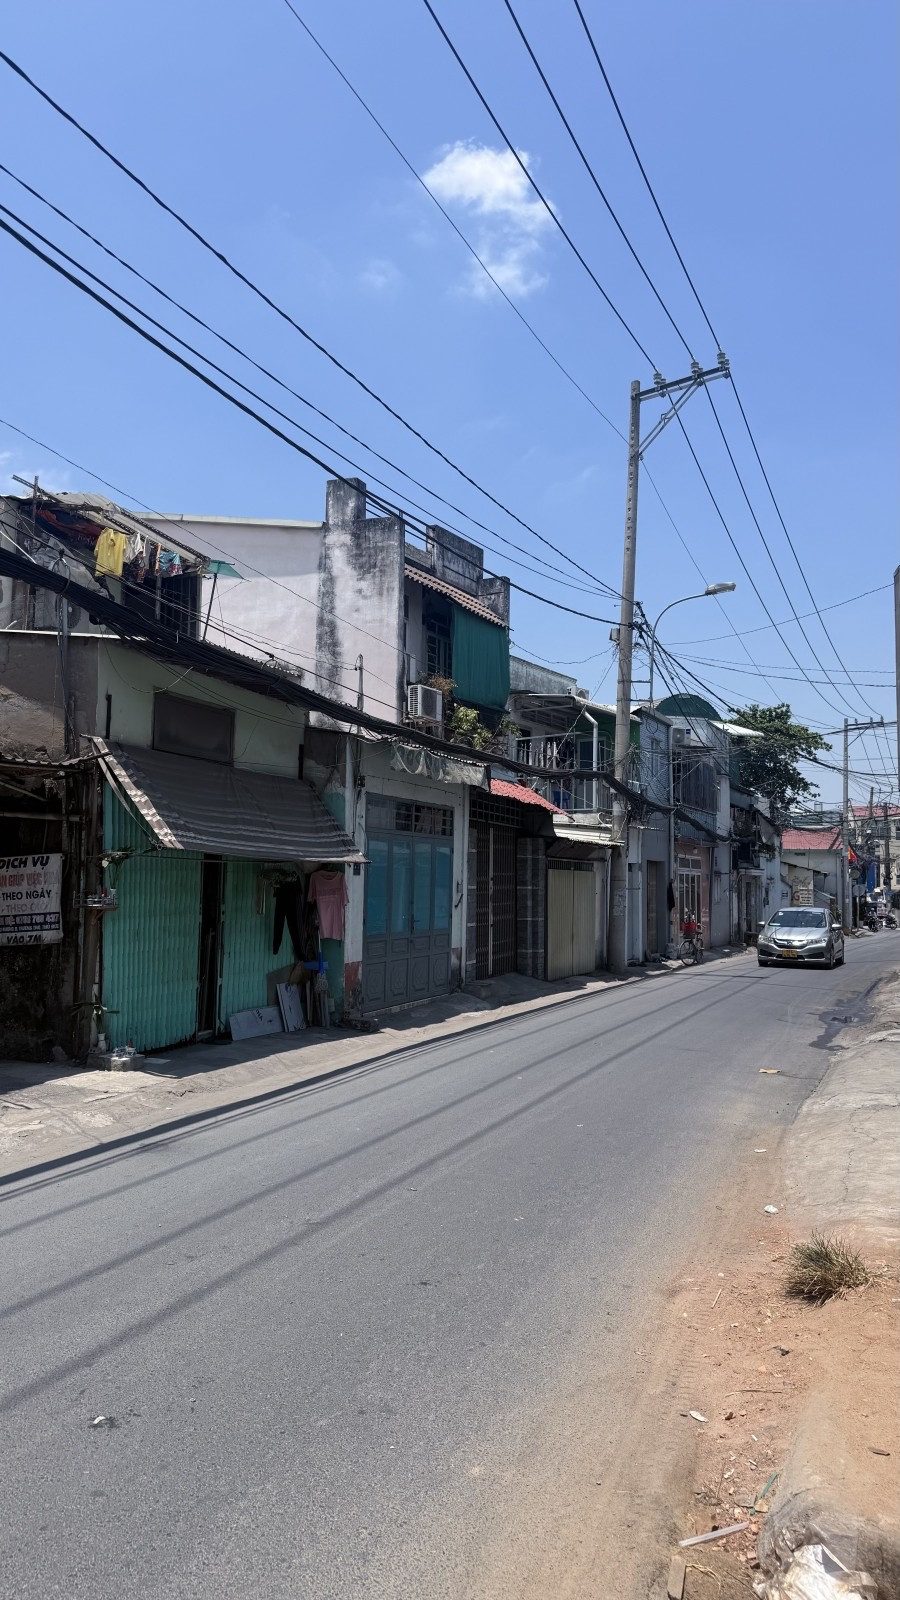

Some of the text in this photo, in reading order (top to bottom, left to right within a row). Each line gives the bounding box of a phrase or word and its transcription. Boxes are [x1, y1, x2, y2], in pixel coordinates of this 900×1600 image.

[0, 856, 50, 872] DỊCH VỤ
[2, 888, 52, 901] THEO NGÀY
[7, 933, 25, 945] VÀO
